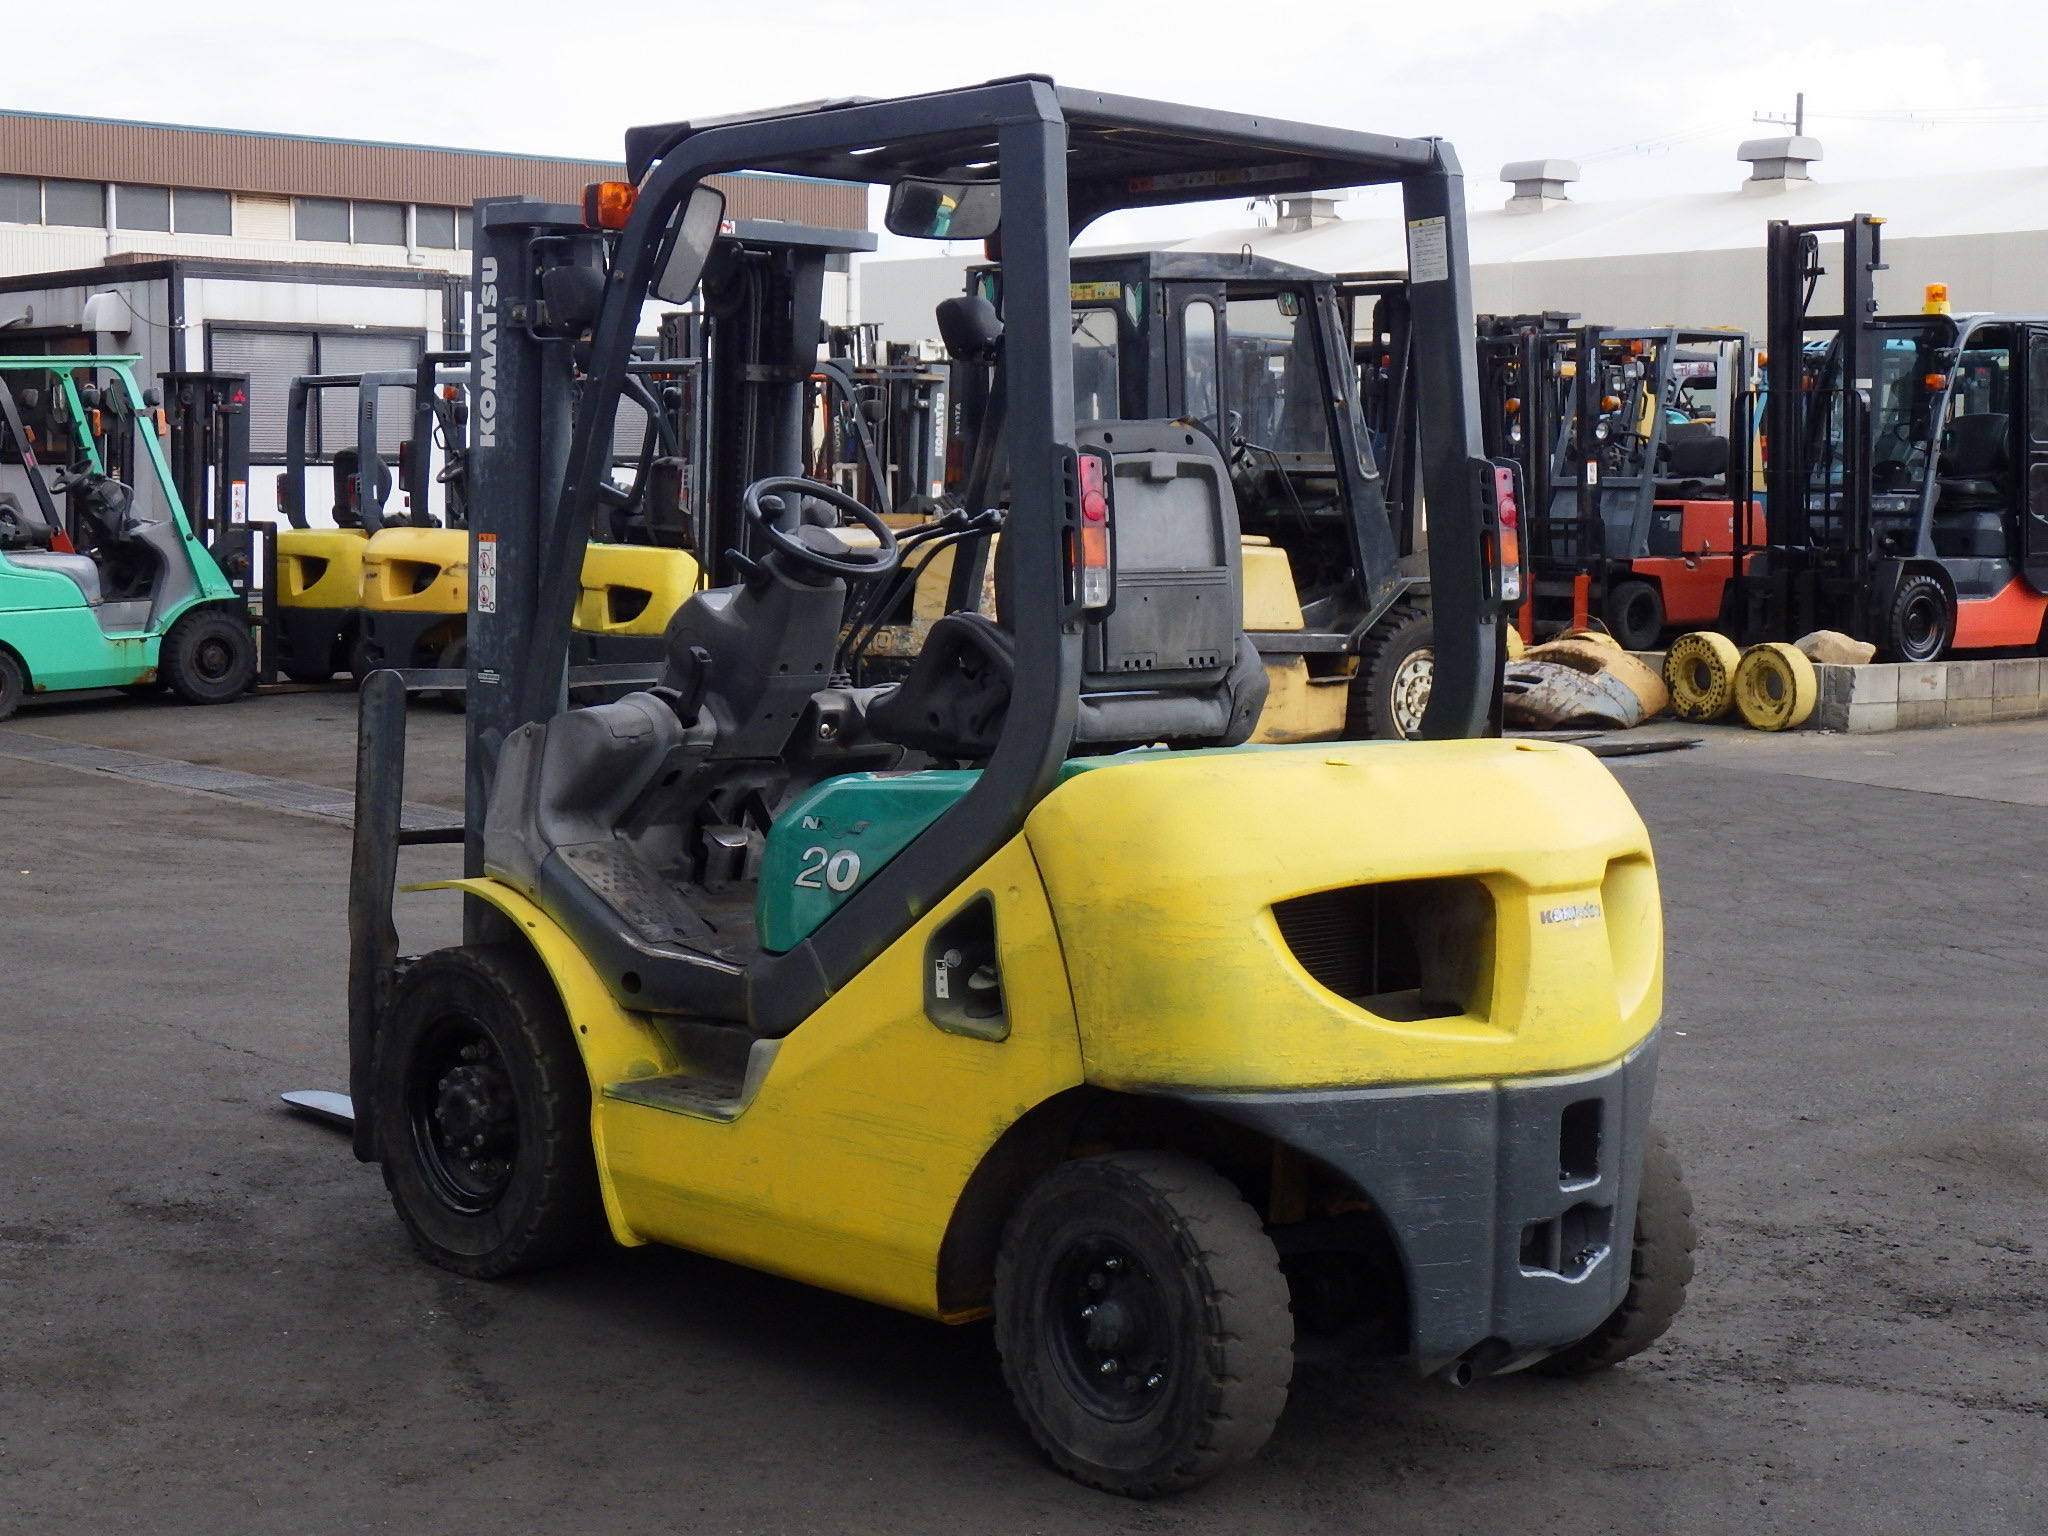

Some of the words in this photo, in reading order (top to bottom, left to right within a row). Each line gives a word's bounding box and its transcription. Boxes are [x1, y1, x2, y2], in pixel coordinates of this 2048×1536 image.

[477, 256, 498, 447] KOMATSU
[934, 392, 945, 457] KOMATSU
[794, 846, 860, 892] 20
